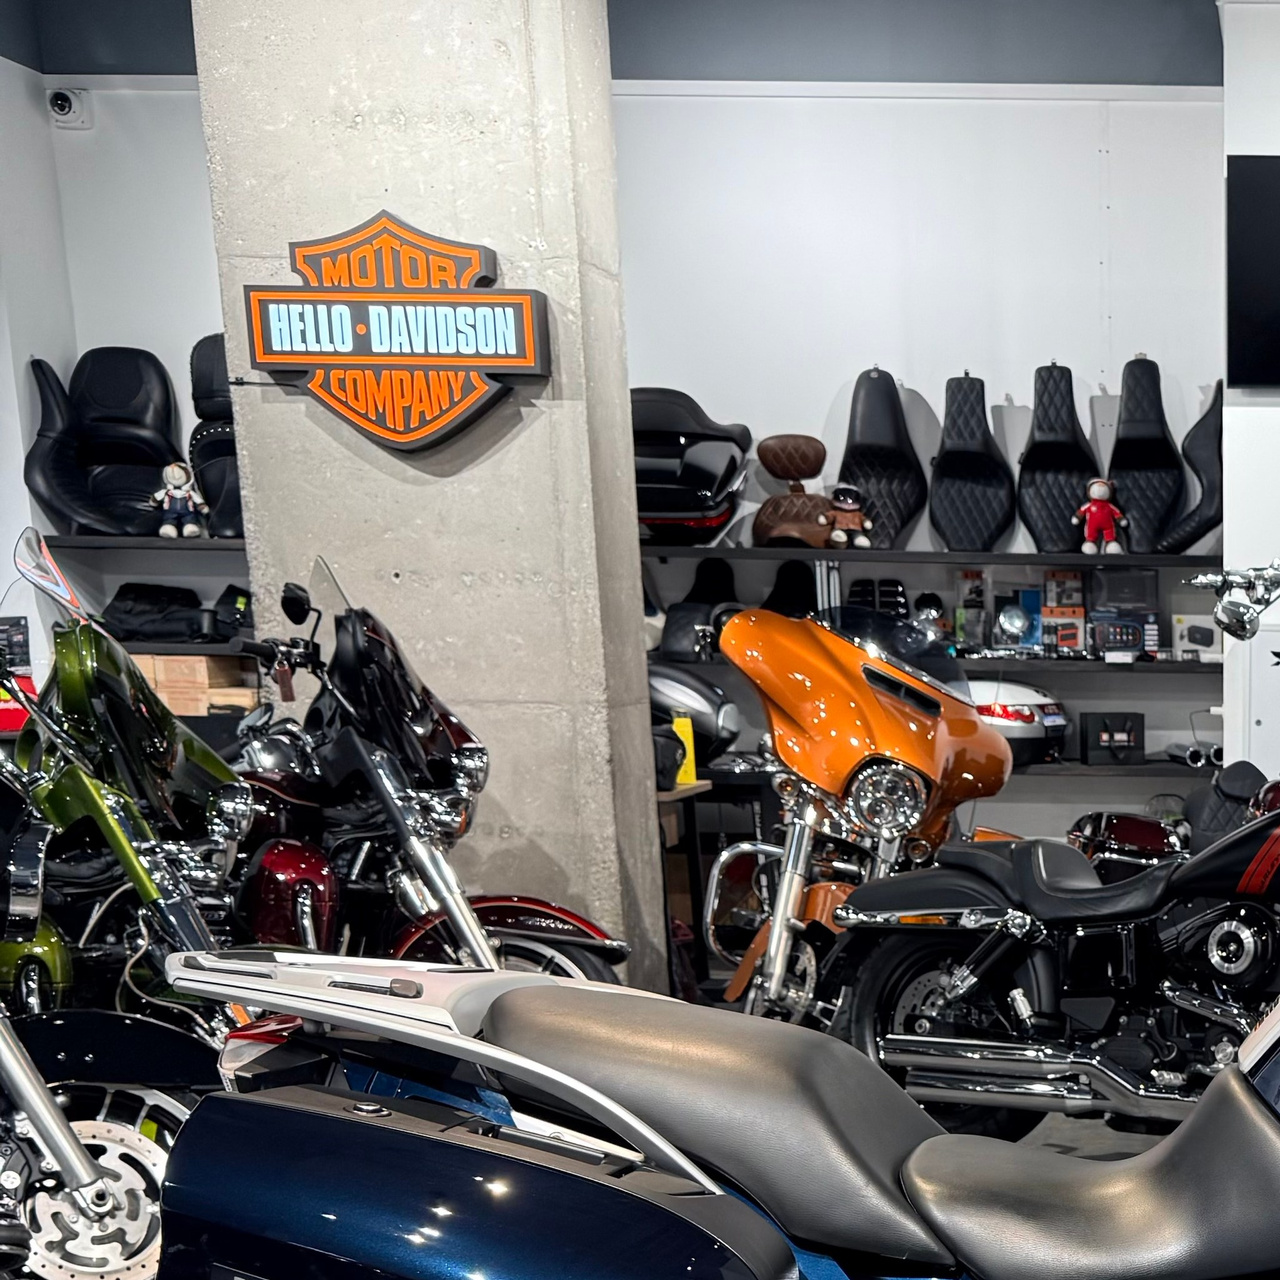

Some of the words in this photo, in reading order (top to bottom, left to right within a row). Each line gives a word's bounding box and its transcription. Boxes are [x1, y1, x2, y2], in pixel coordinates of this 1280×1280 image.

[321, 233, 457, 289] MOTOR
[268, 303, 354, 353] HELLO
[368, 305, 518, 355] DAVIDSON
[329, 369, 467, 431] COMPANY
